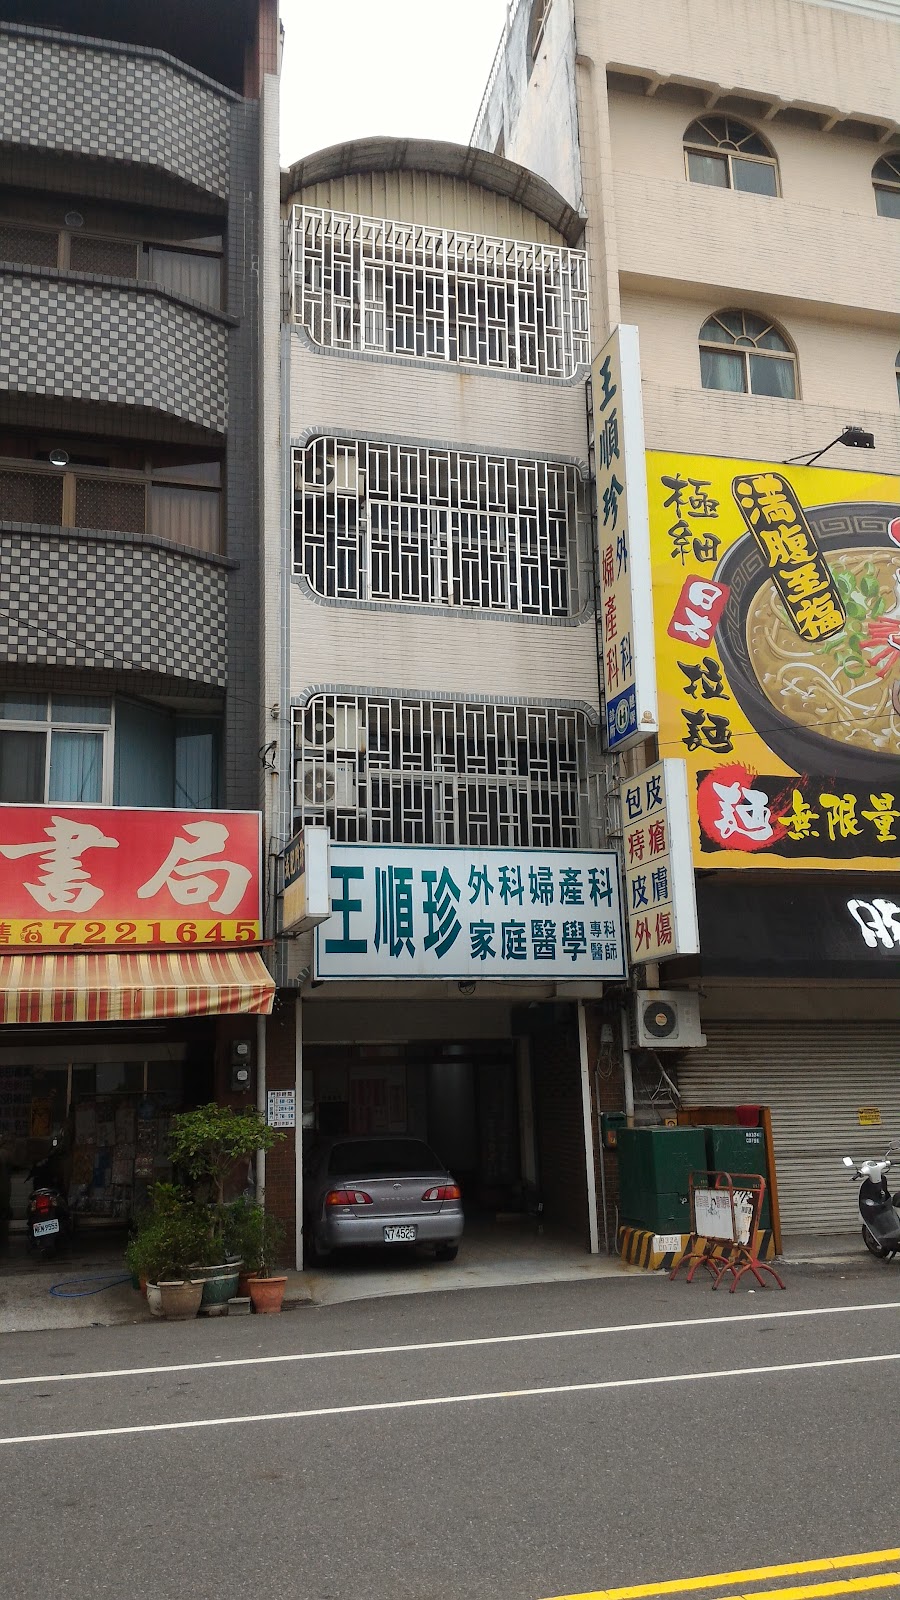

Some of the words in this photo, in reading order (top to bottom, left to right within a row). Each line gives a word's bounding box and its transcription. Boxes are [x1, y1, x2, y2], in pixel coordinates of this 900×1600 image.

[599, 355, 624, 531] 王順珍
[661, 473, 722, 566] 極細
[602, 544, 620, 693] 婦產科
[673, 581, 723, 641] 日本
[625, 775, 663, 820] 包皮
[628, 819, 666, 864] 痔瘡
[0, 815, 253, 915] 書局
[467, 863, 614, 907] 外科婦產科
[632, 865, 669, 909] 皮膚
[53, 921, 257, 944] 7221645
[325, 864, 462, 960] 王順珍
[590, 919, 616, 939] 專科
[635, 911, 672, 952] 外傷
[469, 918, 588, 962] 家庭醫學
[591, 942, 618, 962] 醫師
